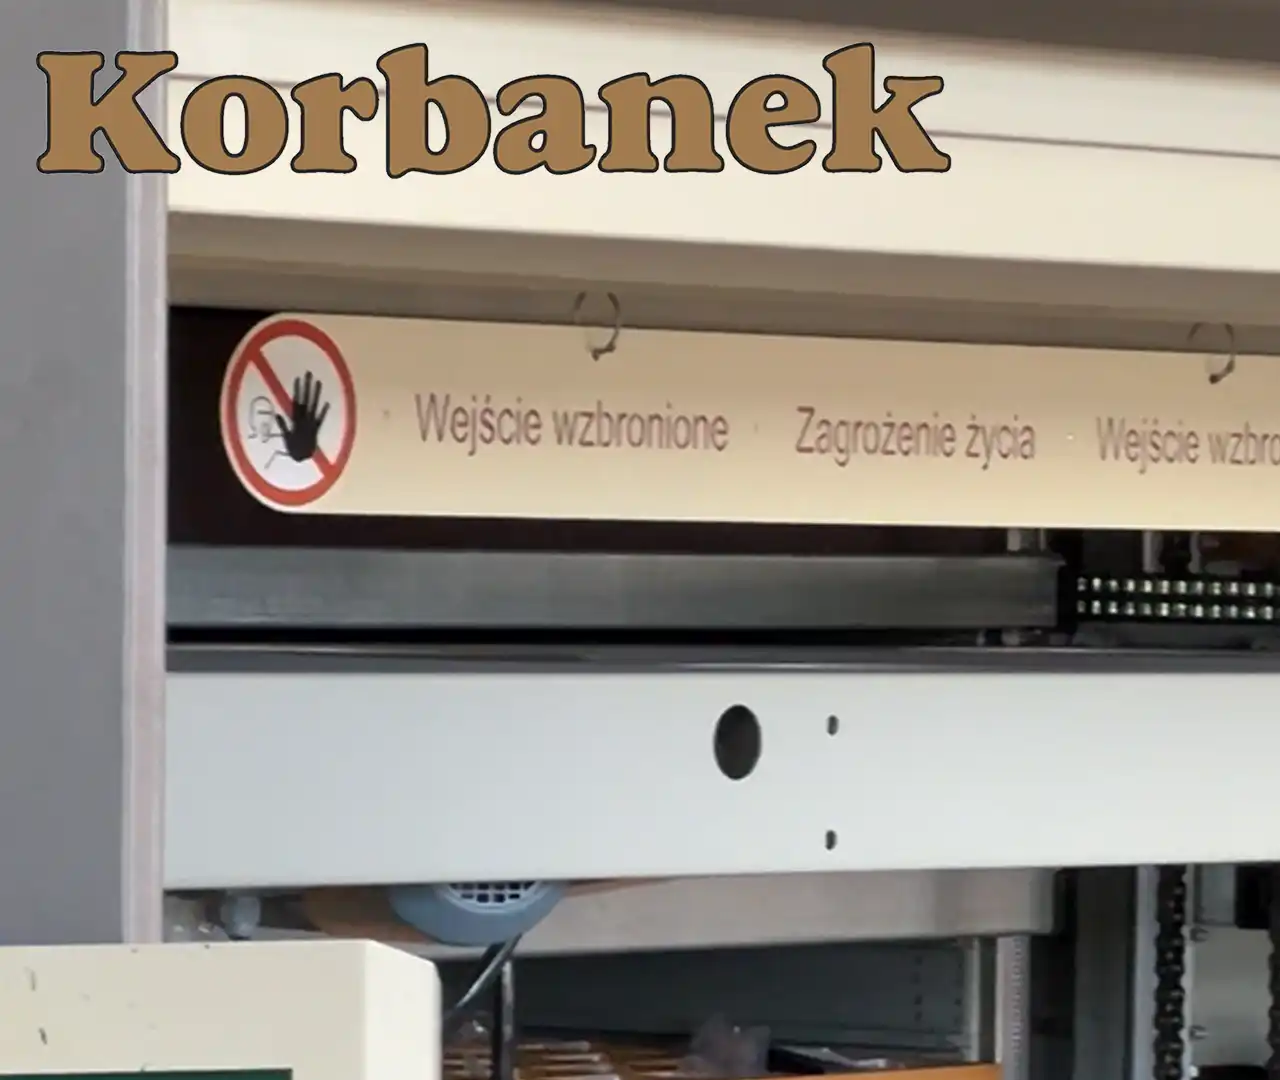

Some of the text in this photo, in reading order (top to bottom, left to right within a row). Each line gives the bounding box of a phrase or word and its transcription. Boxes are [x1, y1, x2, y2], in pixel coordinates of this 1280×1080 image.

[414, 392, 730, 457] Wejście wzbronione
[795, 405, 1036, 471] Zagrożenie życia
[1095, 415, 1200, 475] Wejście
